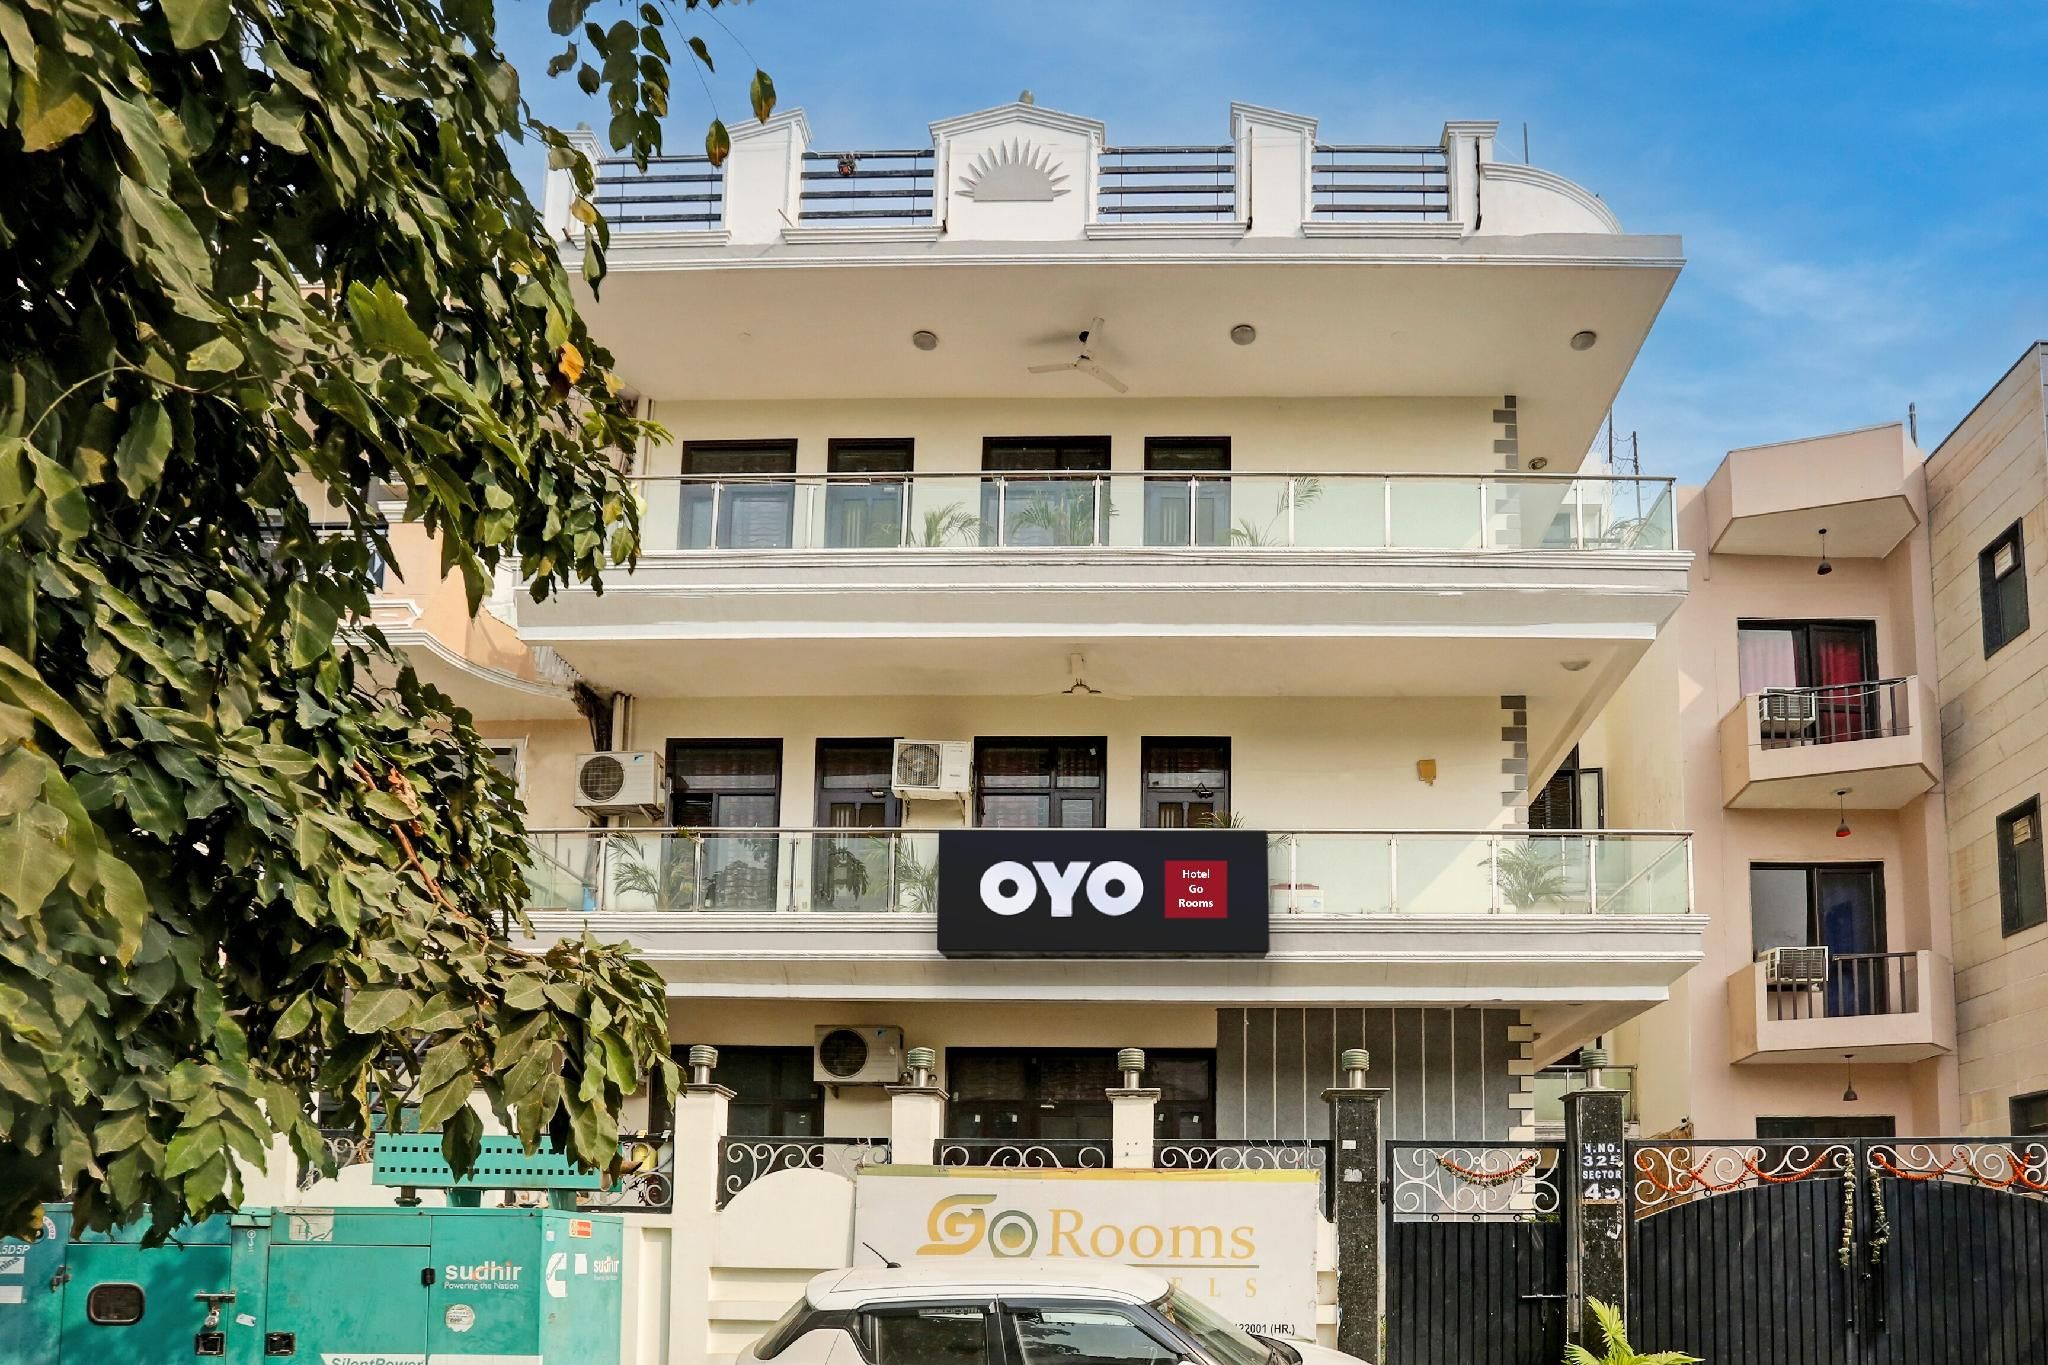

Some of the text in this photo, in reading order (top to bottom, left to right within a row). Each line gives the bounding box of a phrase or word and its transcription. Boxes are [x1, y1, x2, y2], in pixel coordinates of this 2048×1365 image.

[1182, 869, 1210, 879] Hotel
[979, 860, 1144, 917] OYO
[1189, 884, 1204, 894] Go
[1178, 899, 1214, 908] Rooms
[1583, 1170, 1621, 1179] SECTOR
[1584, 1183, 1621, 1200] 45
[1047, 1208, 1257, 1259] Rooms
[0, 1244, 30, 1255] .5D5P
[445, 1260, 523, 1281] sudhir
[444, 1282, 478, 1291] Powering
[480, 1282, 492, 1290] the
[1270, 1324, 1295, 1336] (HR.)
